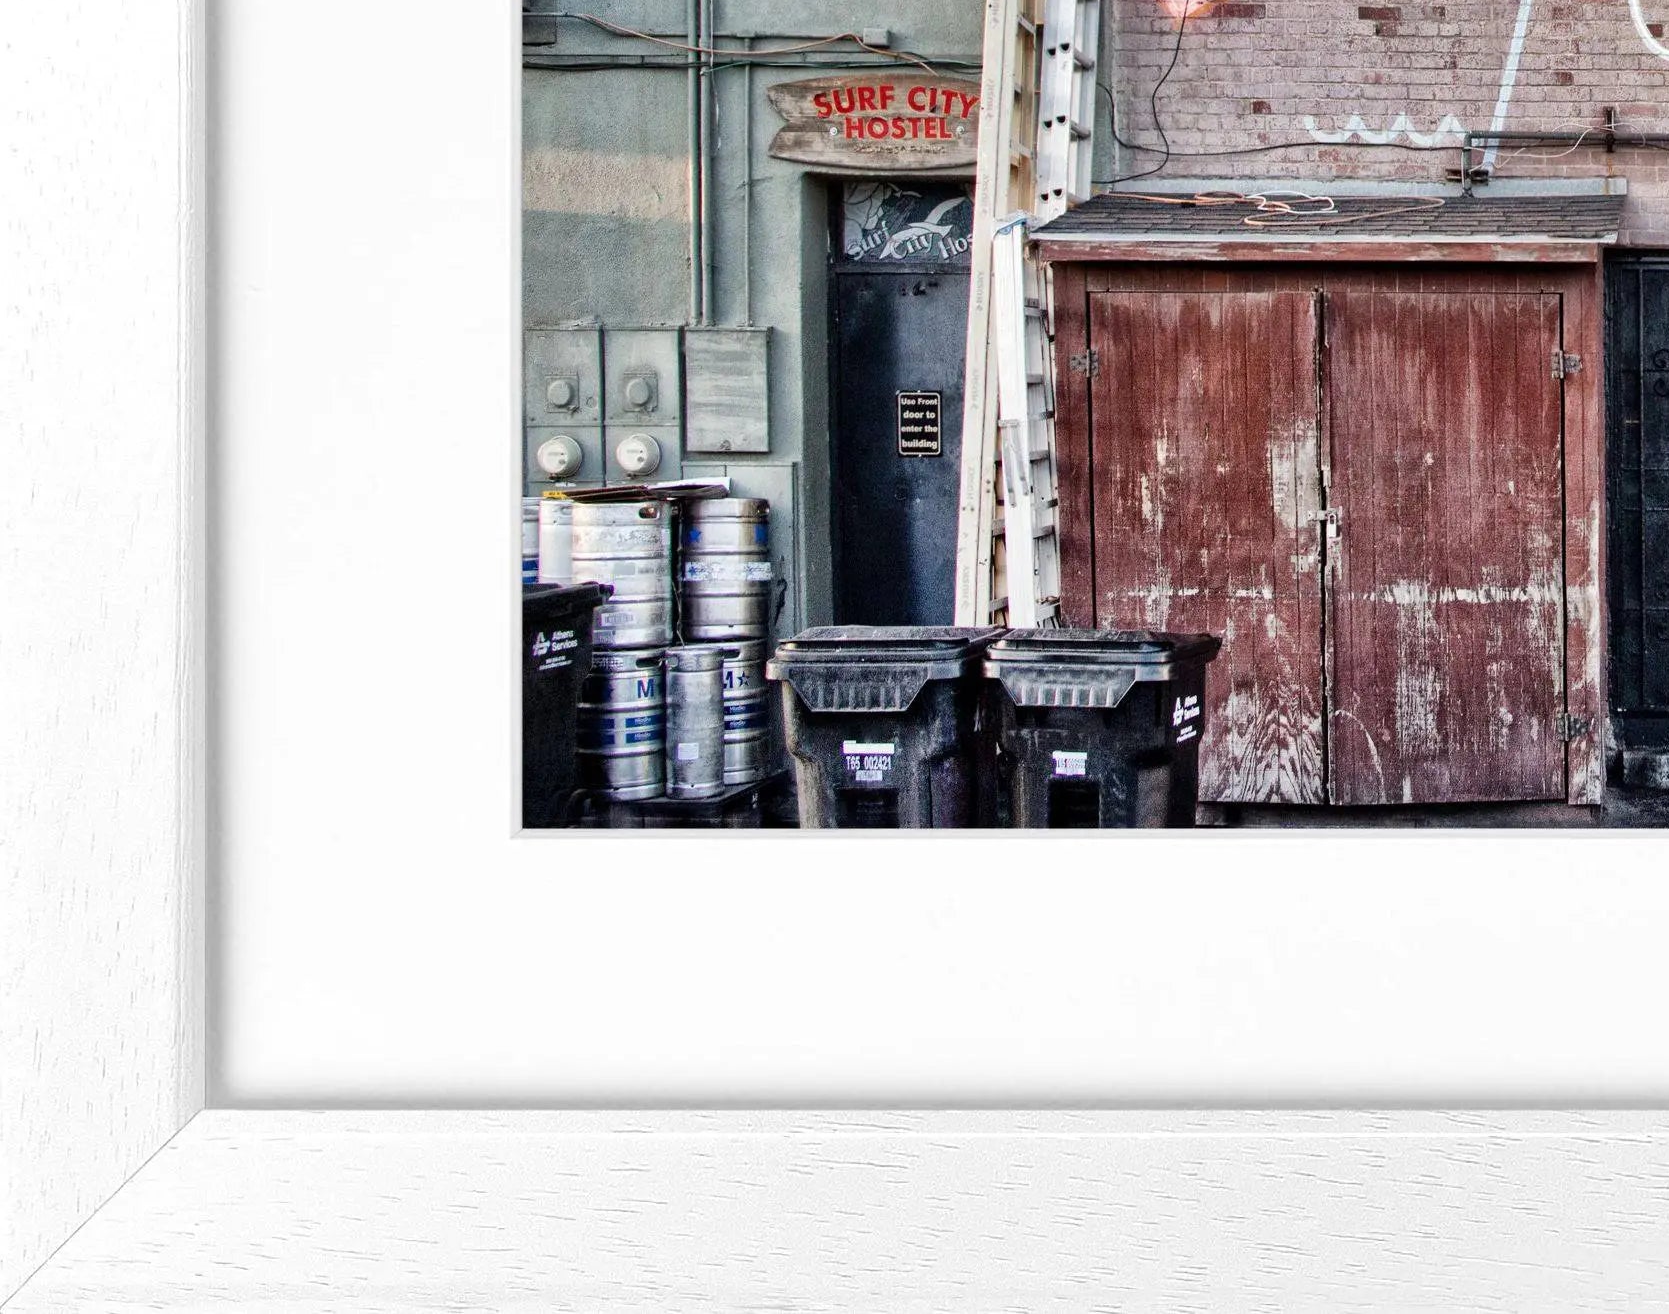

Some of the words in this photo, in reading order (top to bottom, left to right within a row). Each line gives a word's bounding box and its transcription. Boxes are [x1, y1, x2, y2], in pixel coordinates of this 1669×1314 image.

[813, 85, 896, 119] SURF
[907, 85, 981, 119] CITY
[844, 117, 953, 141] HOSTEL
[846, 220, 891, 261] Surf
[889, 232, 936, 260] City
[901, 397, 916, 406] Use
[917, 397, 938, 406] Front
[903, 410, 924, 419] door
[926, 410, 936, 419] to
[901, 425, 922, 433] enter
[924, 424, 938, 433] the
[901, 439, 938, 450] building
[552, 640, 578, 652] Services
